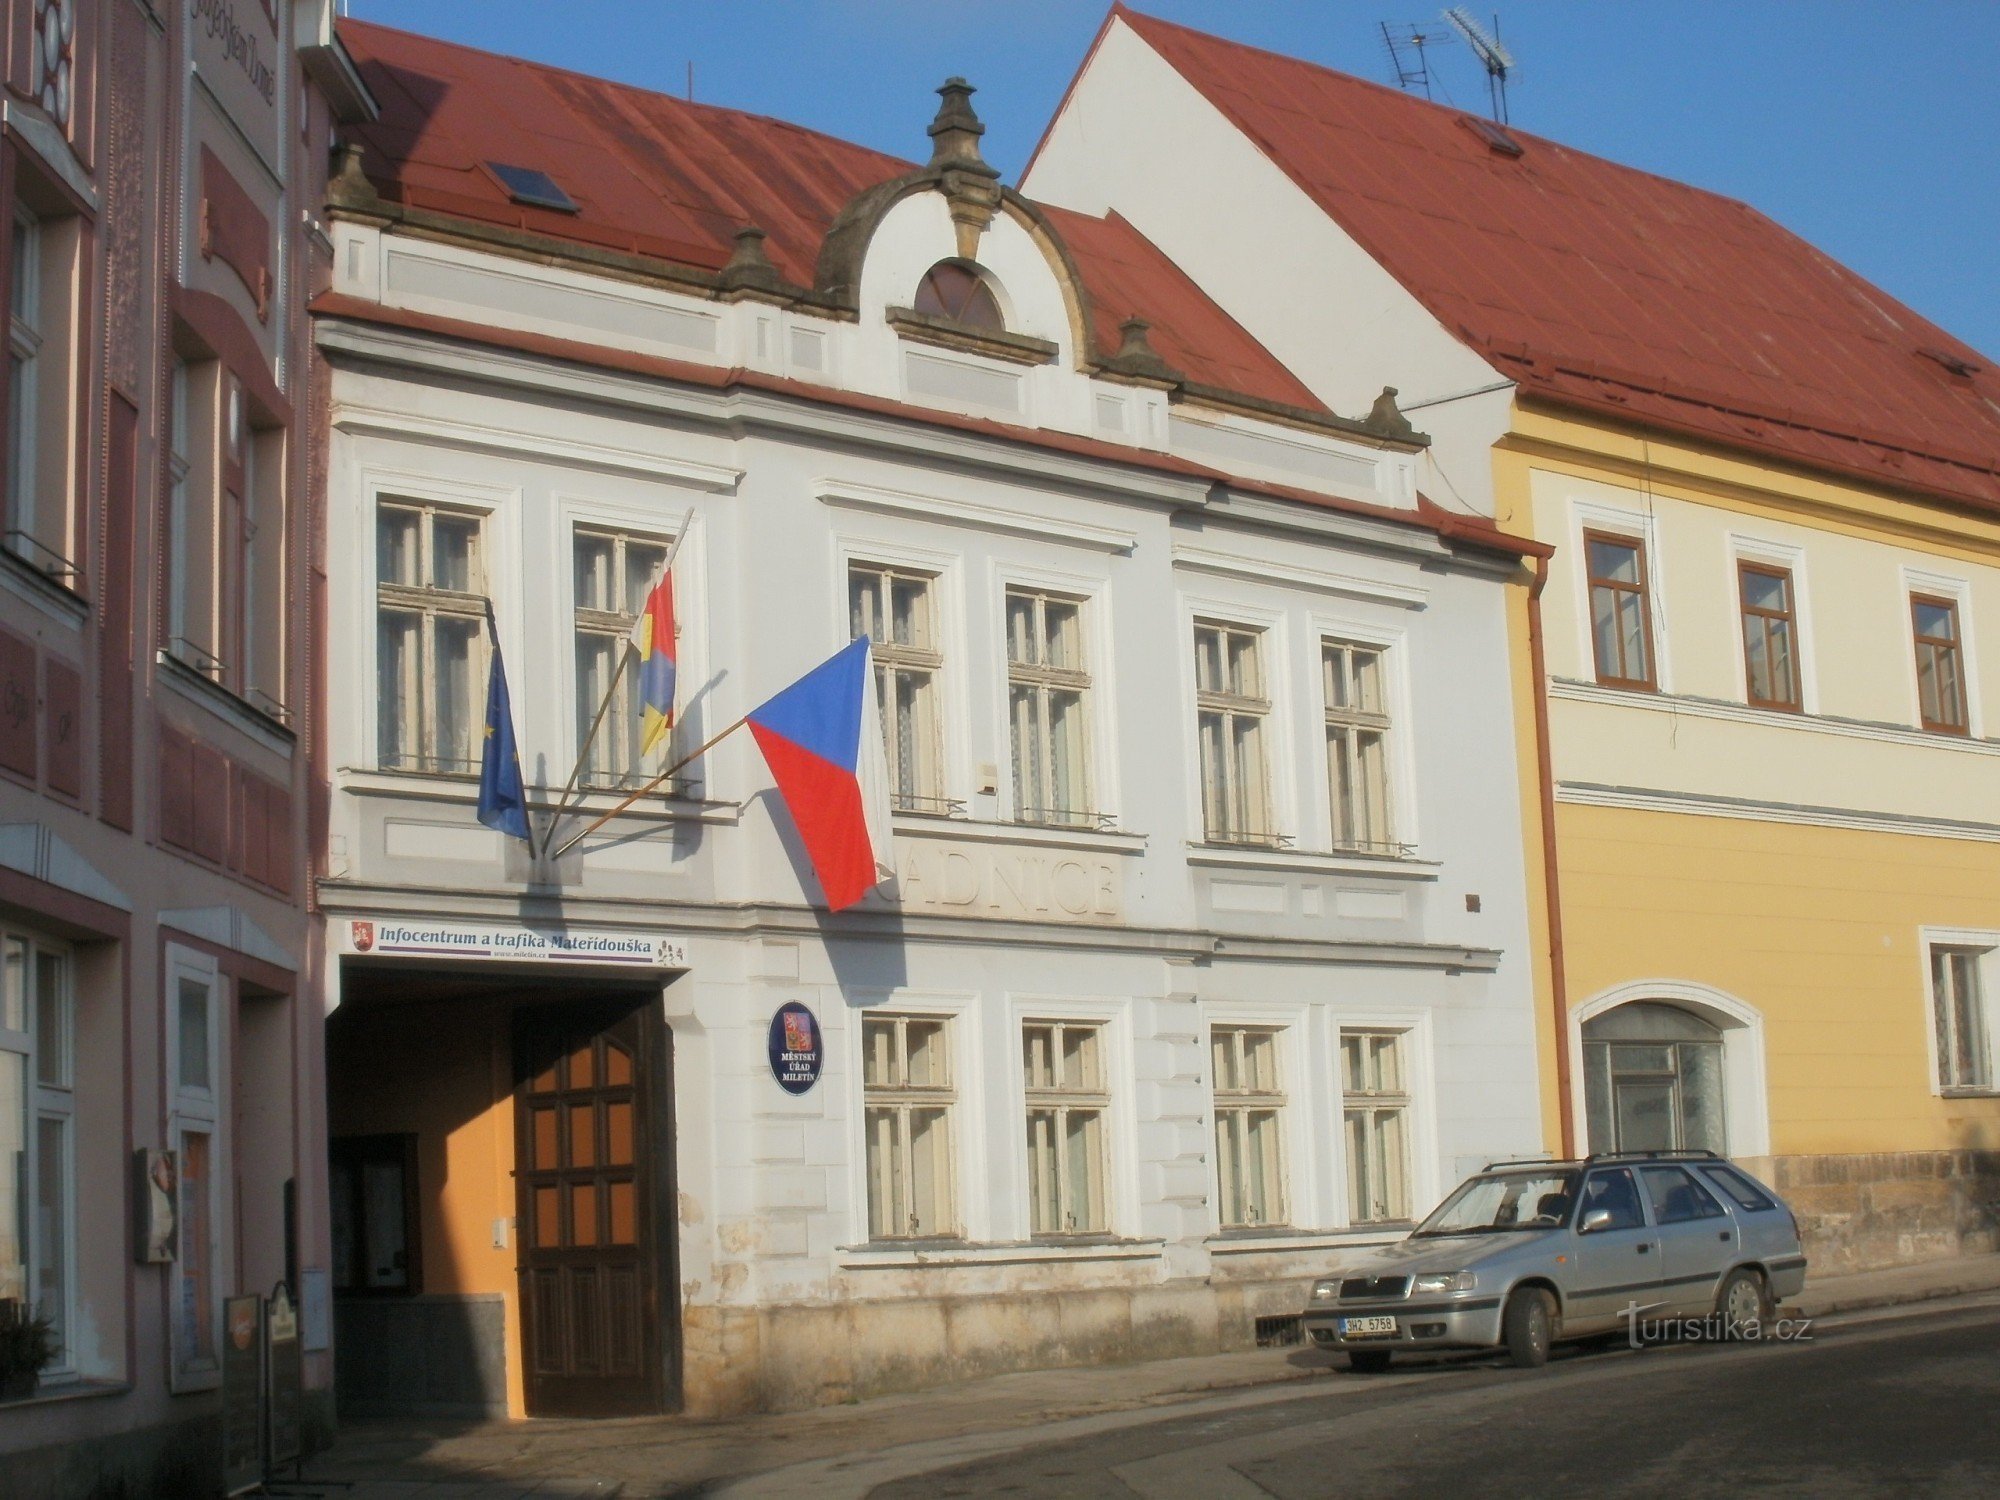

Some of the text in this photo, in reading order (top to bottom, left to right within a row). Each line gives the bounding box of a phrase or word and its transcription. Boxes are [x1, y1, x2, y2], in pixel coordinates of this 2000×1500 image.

[873, 846, 1118, 916] ADNICE
[380, 927, 652, 953] Infocentrum a trafika Mateřídouška
[781, 1051, 816, 1061] MĚSTSKÝ
[789, 1061, 810, 1071] ÚŘAD
[782, 1072, 815, 1081] MILETÍN
